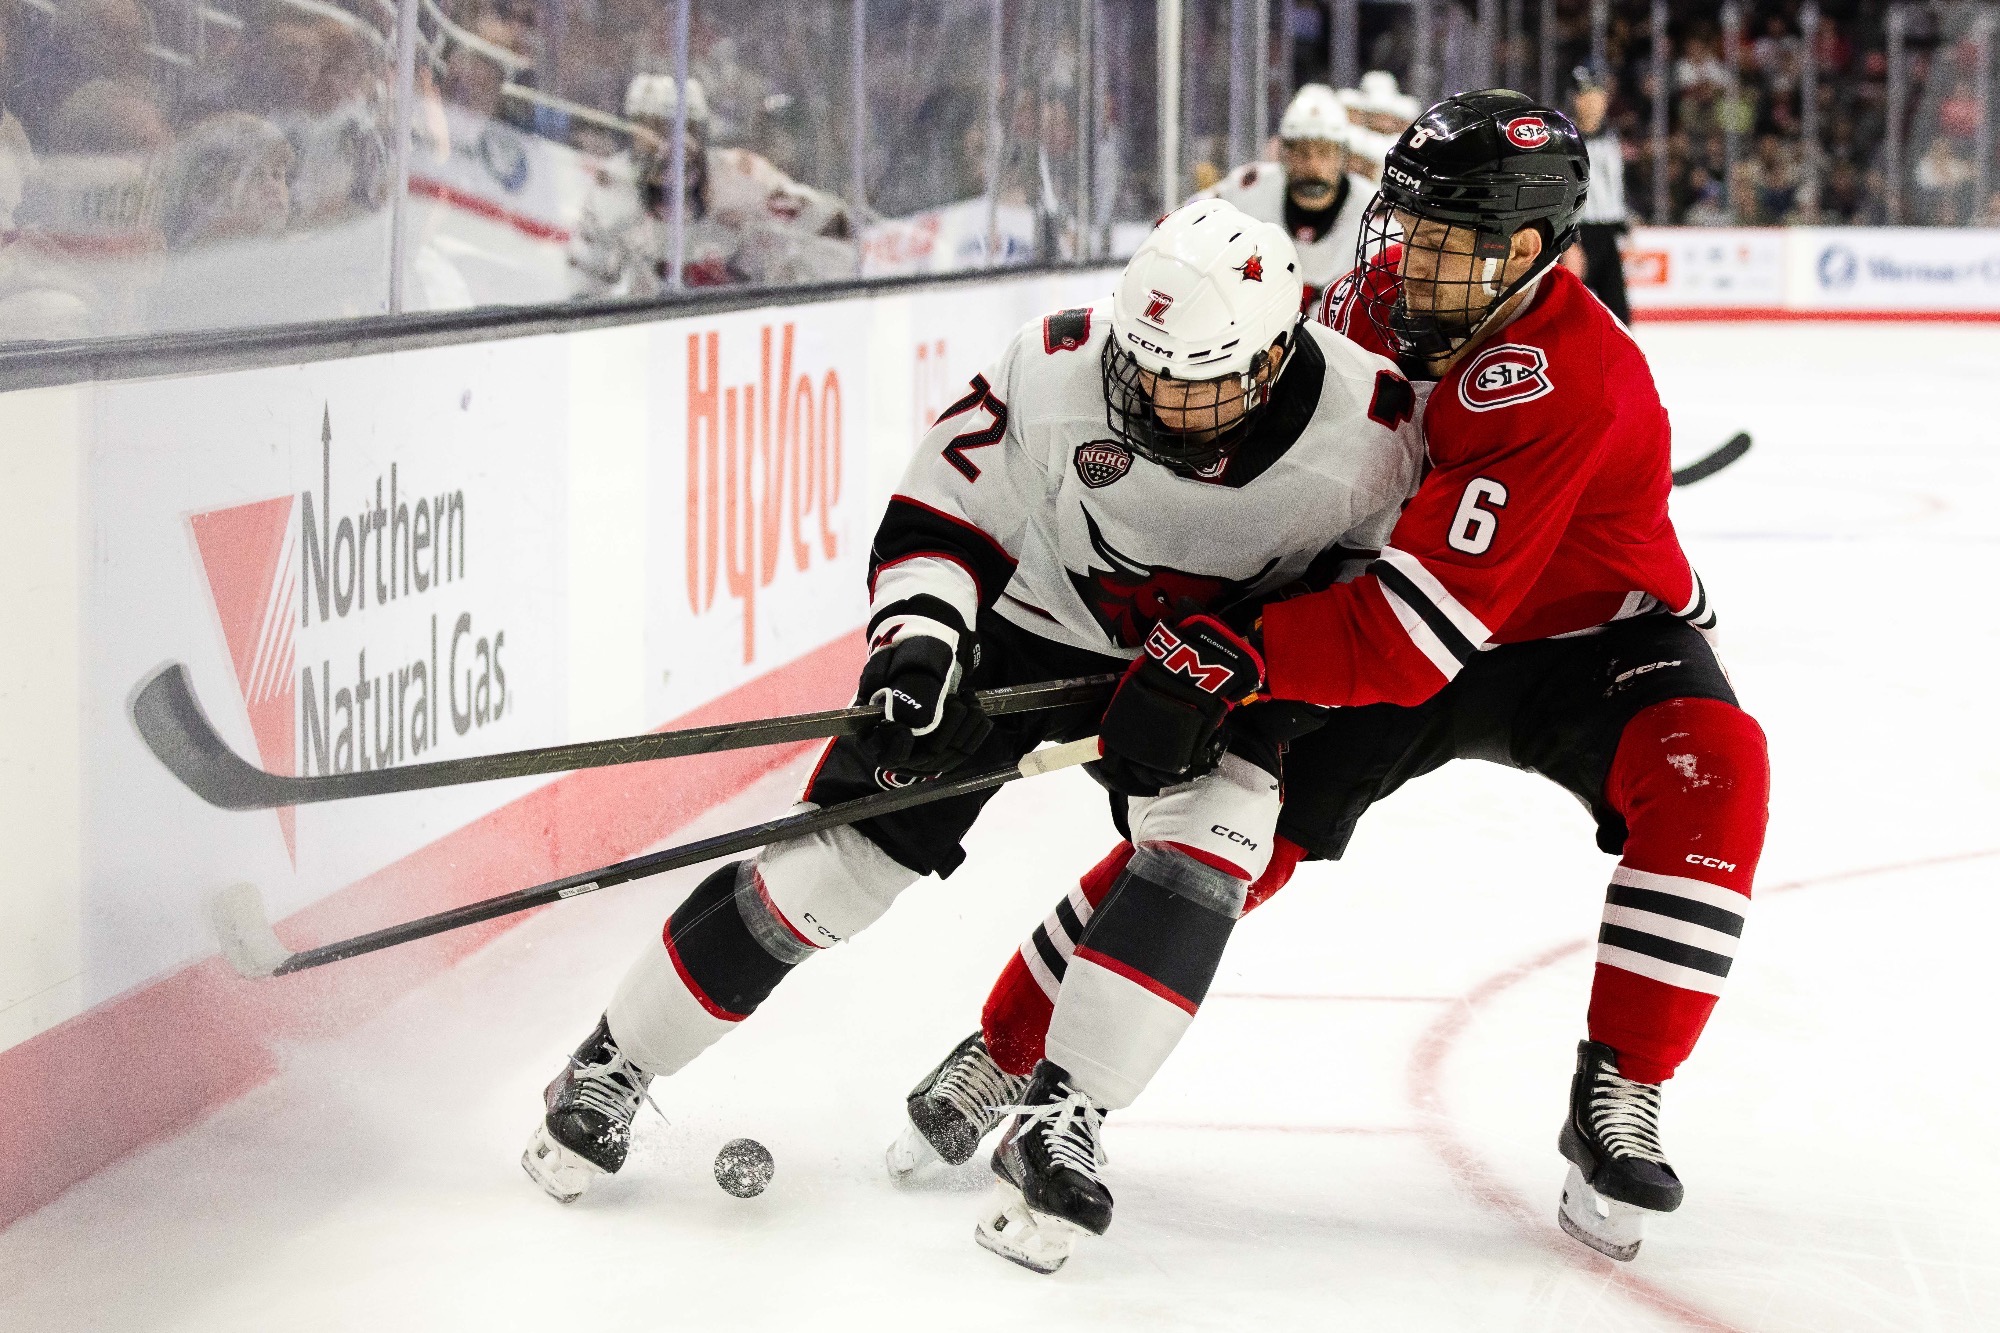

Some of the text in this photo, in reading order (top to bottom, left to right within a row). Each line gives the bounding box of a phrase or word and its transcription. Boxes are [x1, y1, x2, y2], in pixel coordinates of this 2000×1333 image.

[1409, 129, 1436, 149] 6
[1387, 165, 1422, 190] CCM
[1143, 289, 1174, 325] 72
[1127, 332, 1174, 359] CCM
[924, 371, 1008, 484] 72
[1081, 450, 1129, 470] NCHC
[301, 402, 465, 628] Northern
[1446, 475, 1510, 557] 6
[1144, 619, 1235, 694] CM
[301, 610, 506, 778] Natural Gas
[892, 689, 922, 710] CCM
[1210, 824, 1258, 851] CCM
[1685, 853, 1737, 873] CCM
[803, 912, 842, 942] CCM
